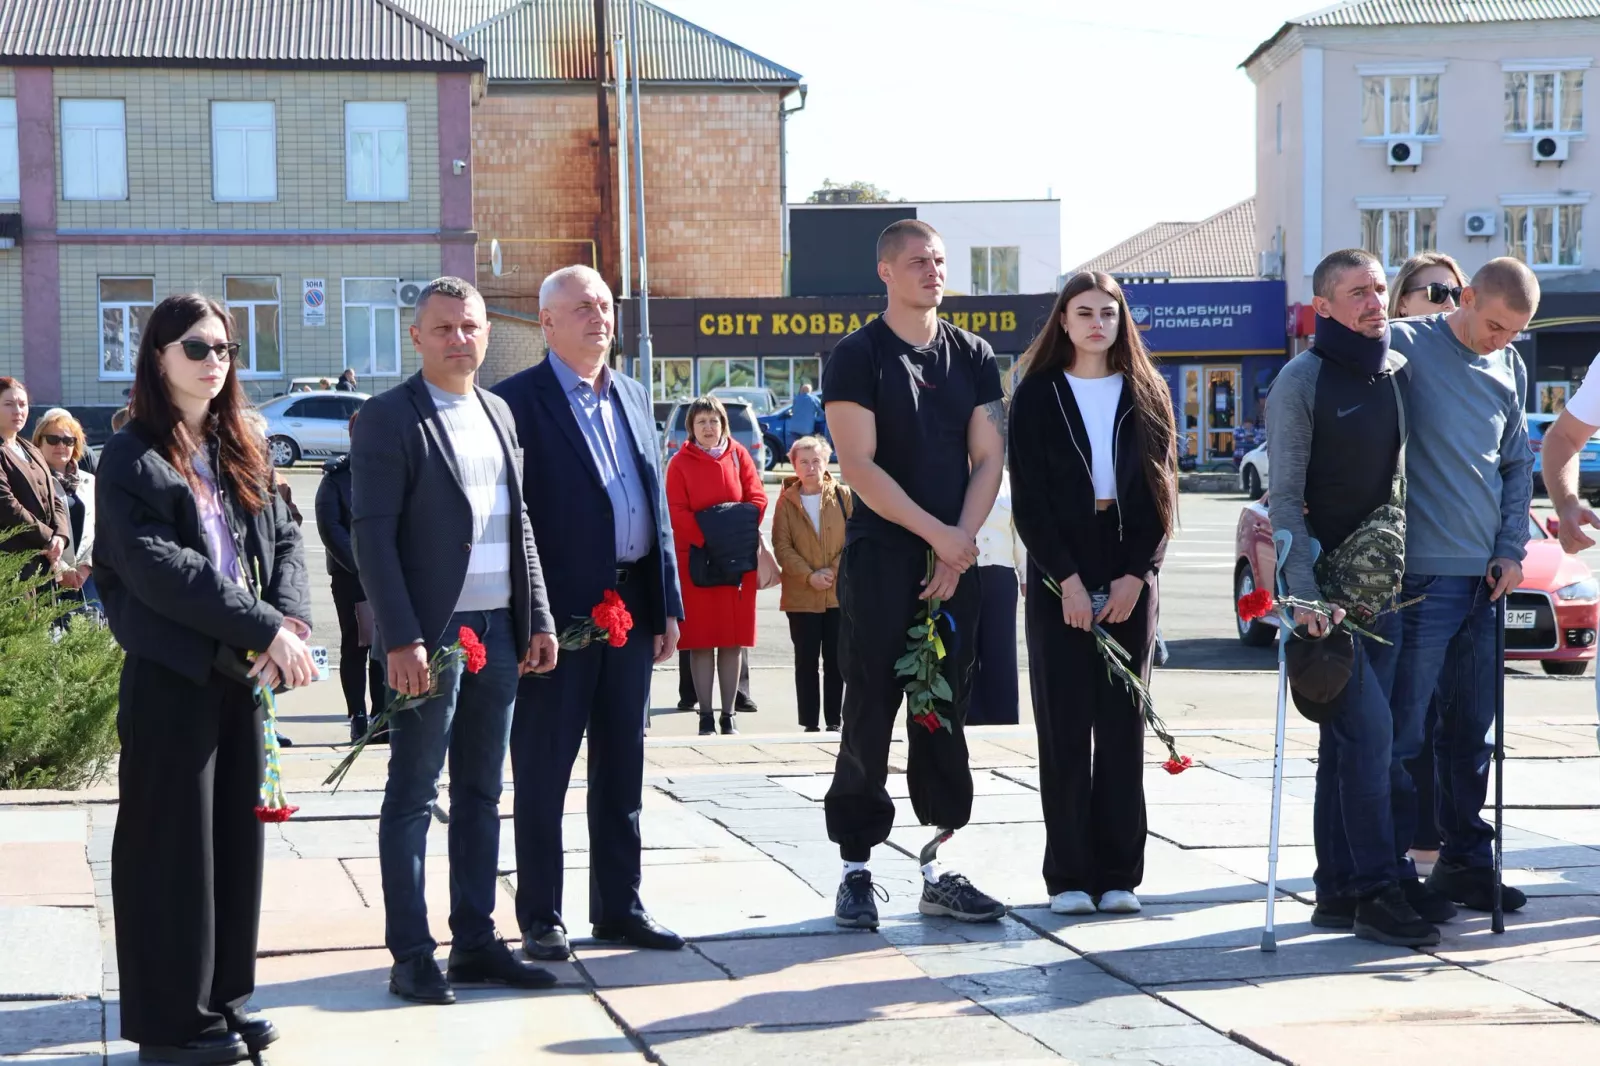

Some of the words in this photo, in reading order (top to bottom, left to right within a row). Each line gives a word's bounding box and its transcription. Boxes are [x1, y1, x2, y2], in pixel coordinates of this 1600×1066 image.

[306, 281, 323, 289] ЗОНА
[1154, 304, 1252, 316] СКАРБНИЦЯ
[699, 313, 763, 335] СВІТ
[1154, 317, 1233, 328] ЛОМБАРД
[1516, 612, 1533, 624] ME
